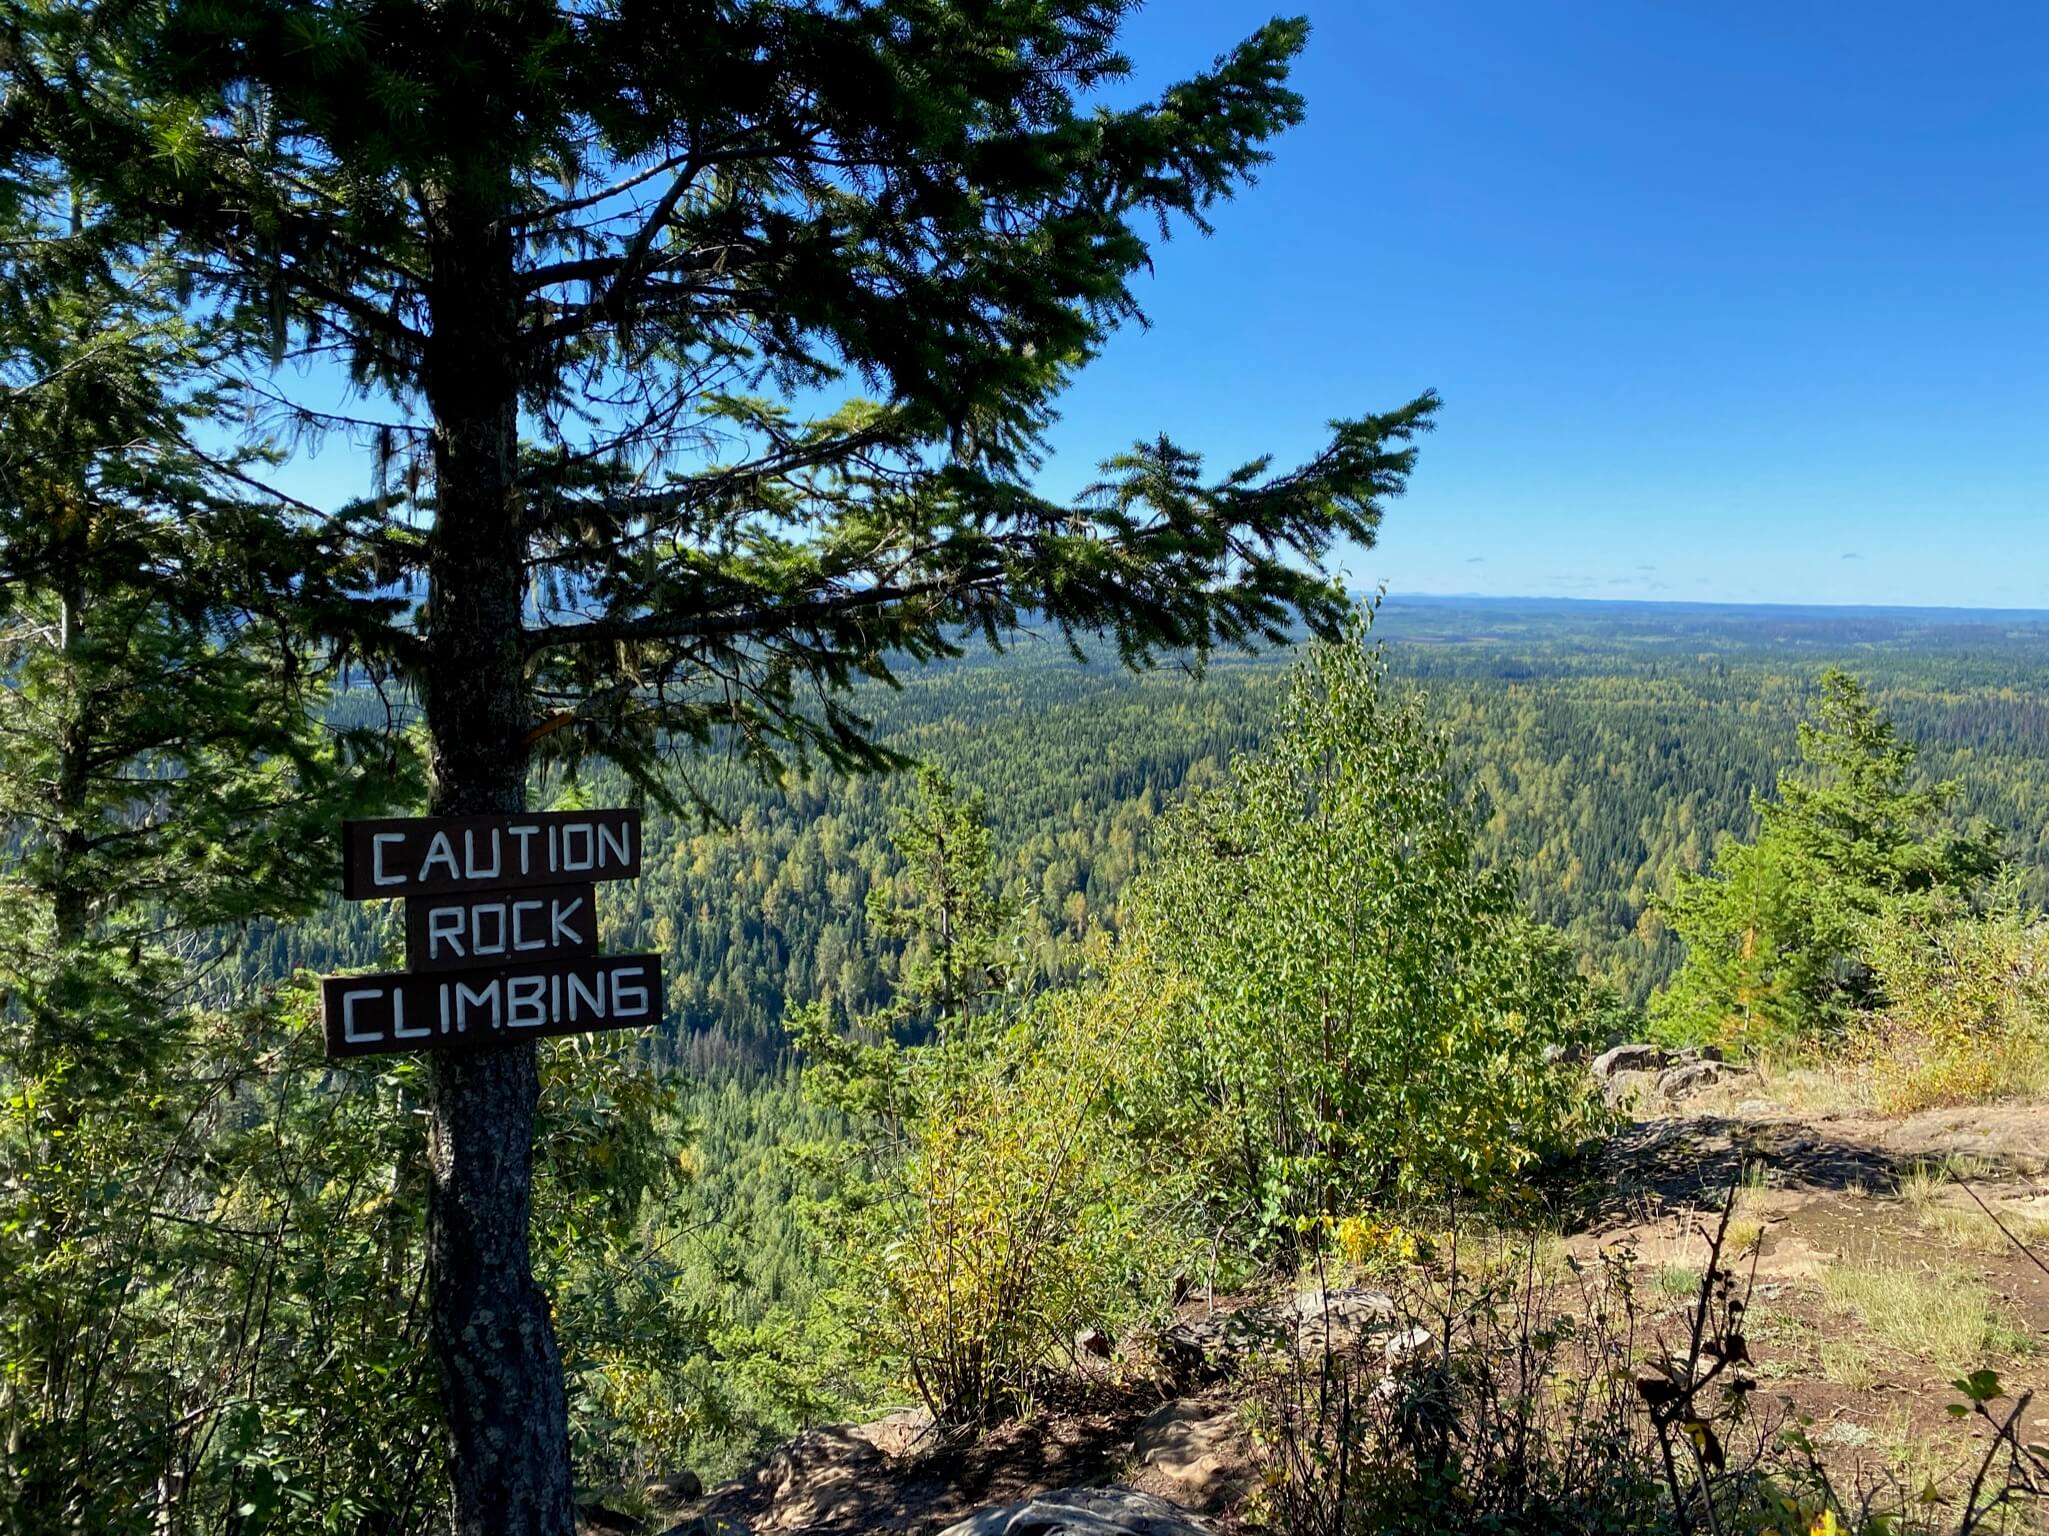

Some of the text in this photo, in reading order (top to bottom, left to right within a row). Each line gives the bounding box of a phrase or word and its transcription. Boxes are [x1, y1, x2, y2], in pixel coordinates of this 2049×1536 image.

[373, 821, 630, 886] CAUTION
[429, 897, 583, 960] ROCK
[343, 967, 649, 1043] CLIMBING
